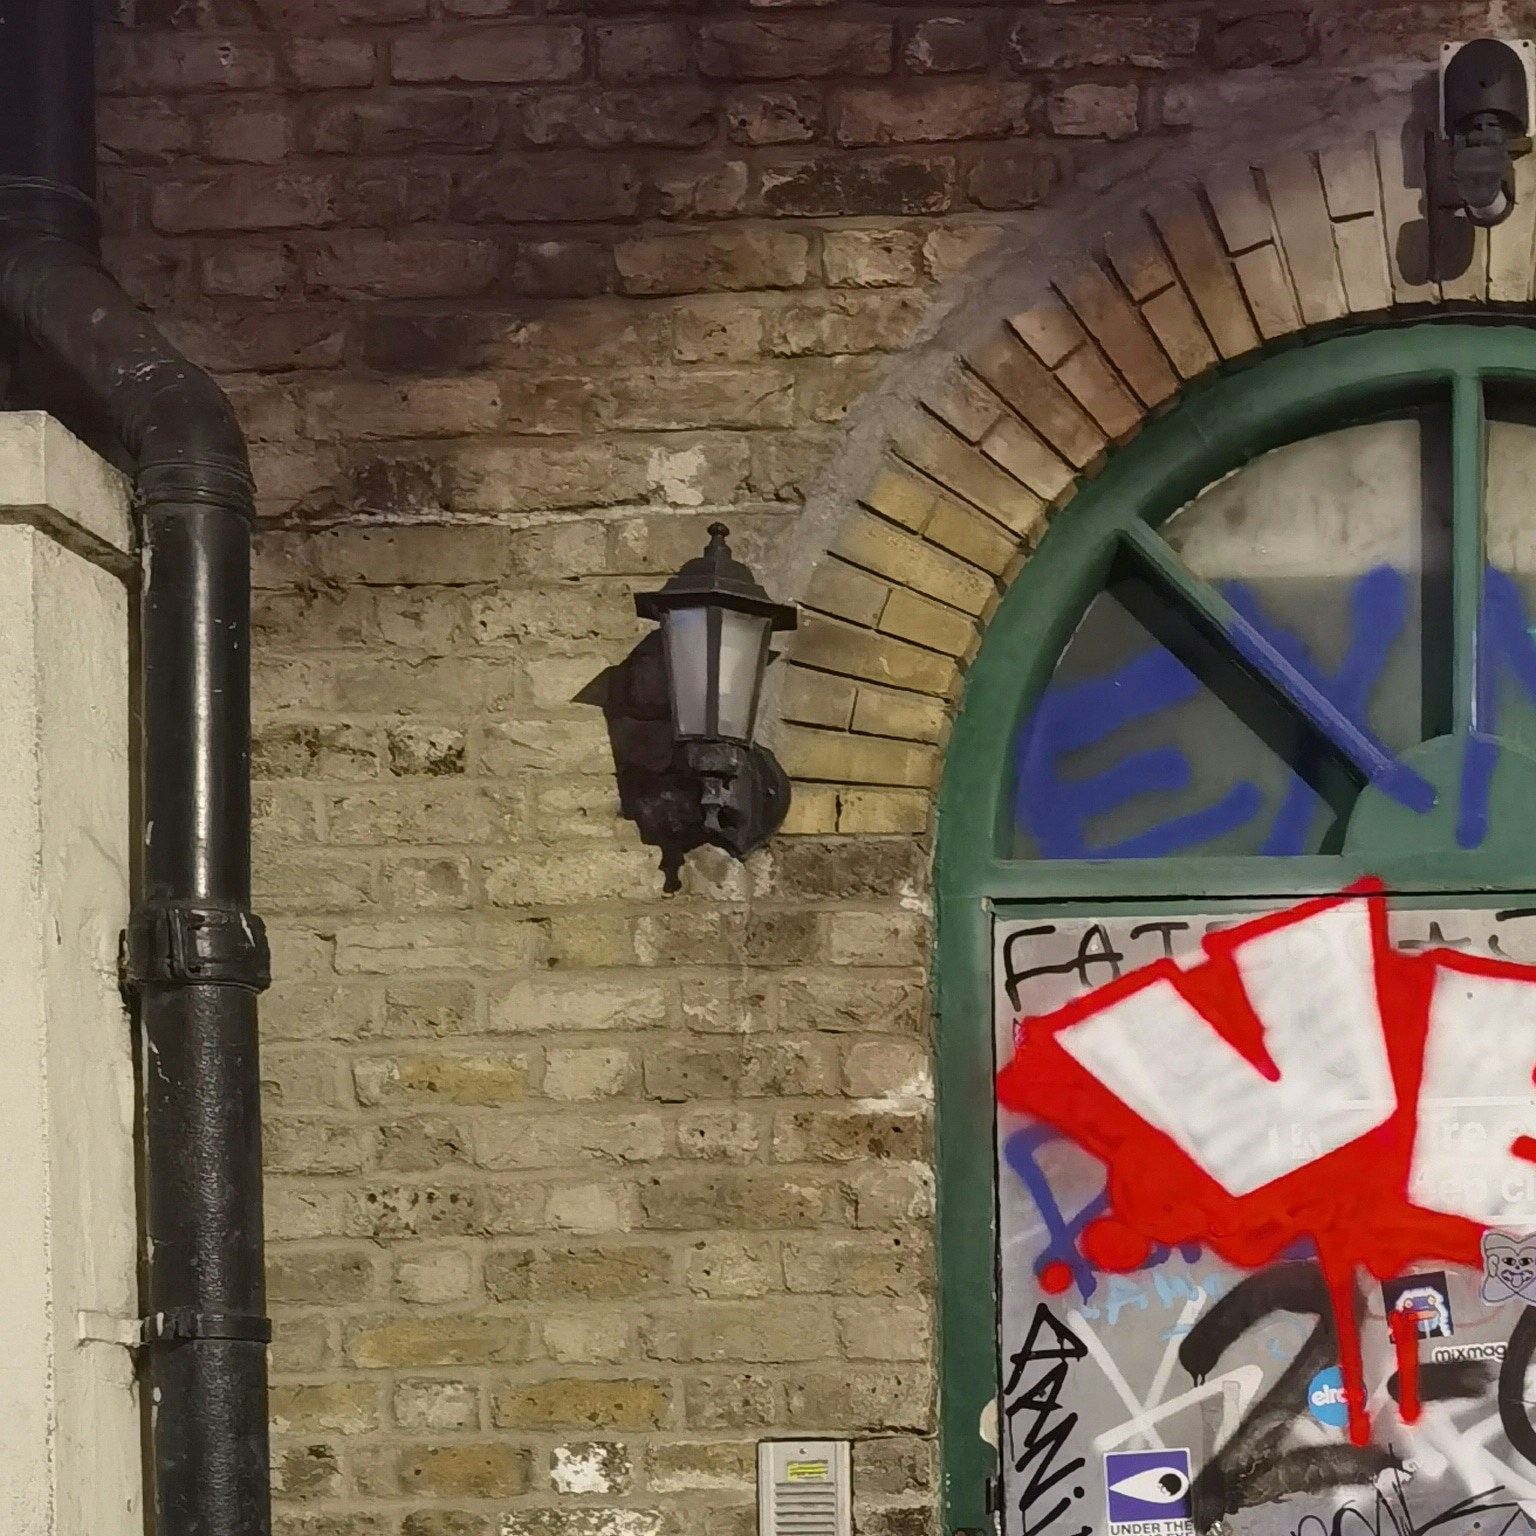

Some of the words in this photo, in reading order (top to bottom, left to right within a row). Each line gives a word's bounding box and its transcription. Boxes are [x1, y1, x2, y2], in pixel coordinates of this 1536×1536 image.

[1435, 1345, 1505, 1362] mixmag
[1110, 1523, 1161, 1536] UNDER
[1164, 1520, 1193, 1532] THE
